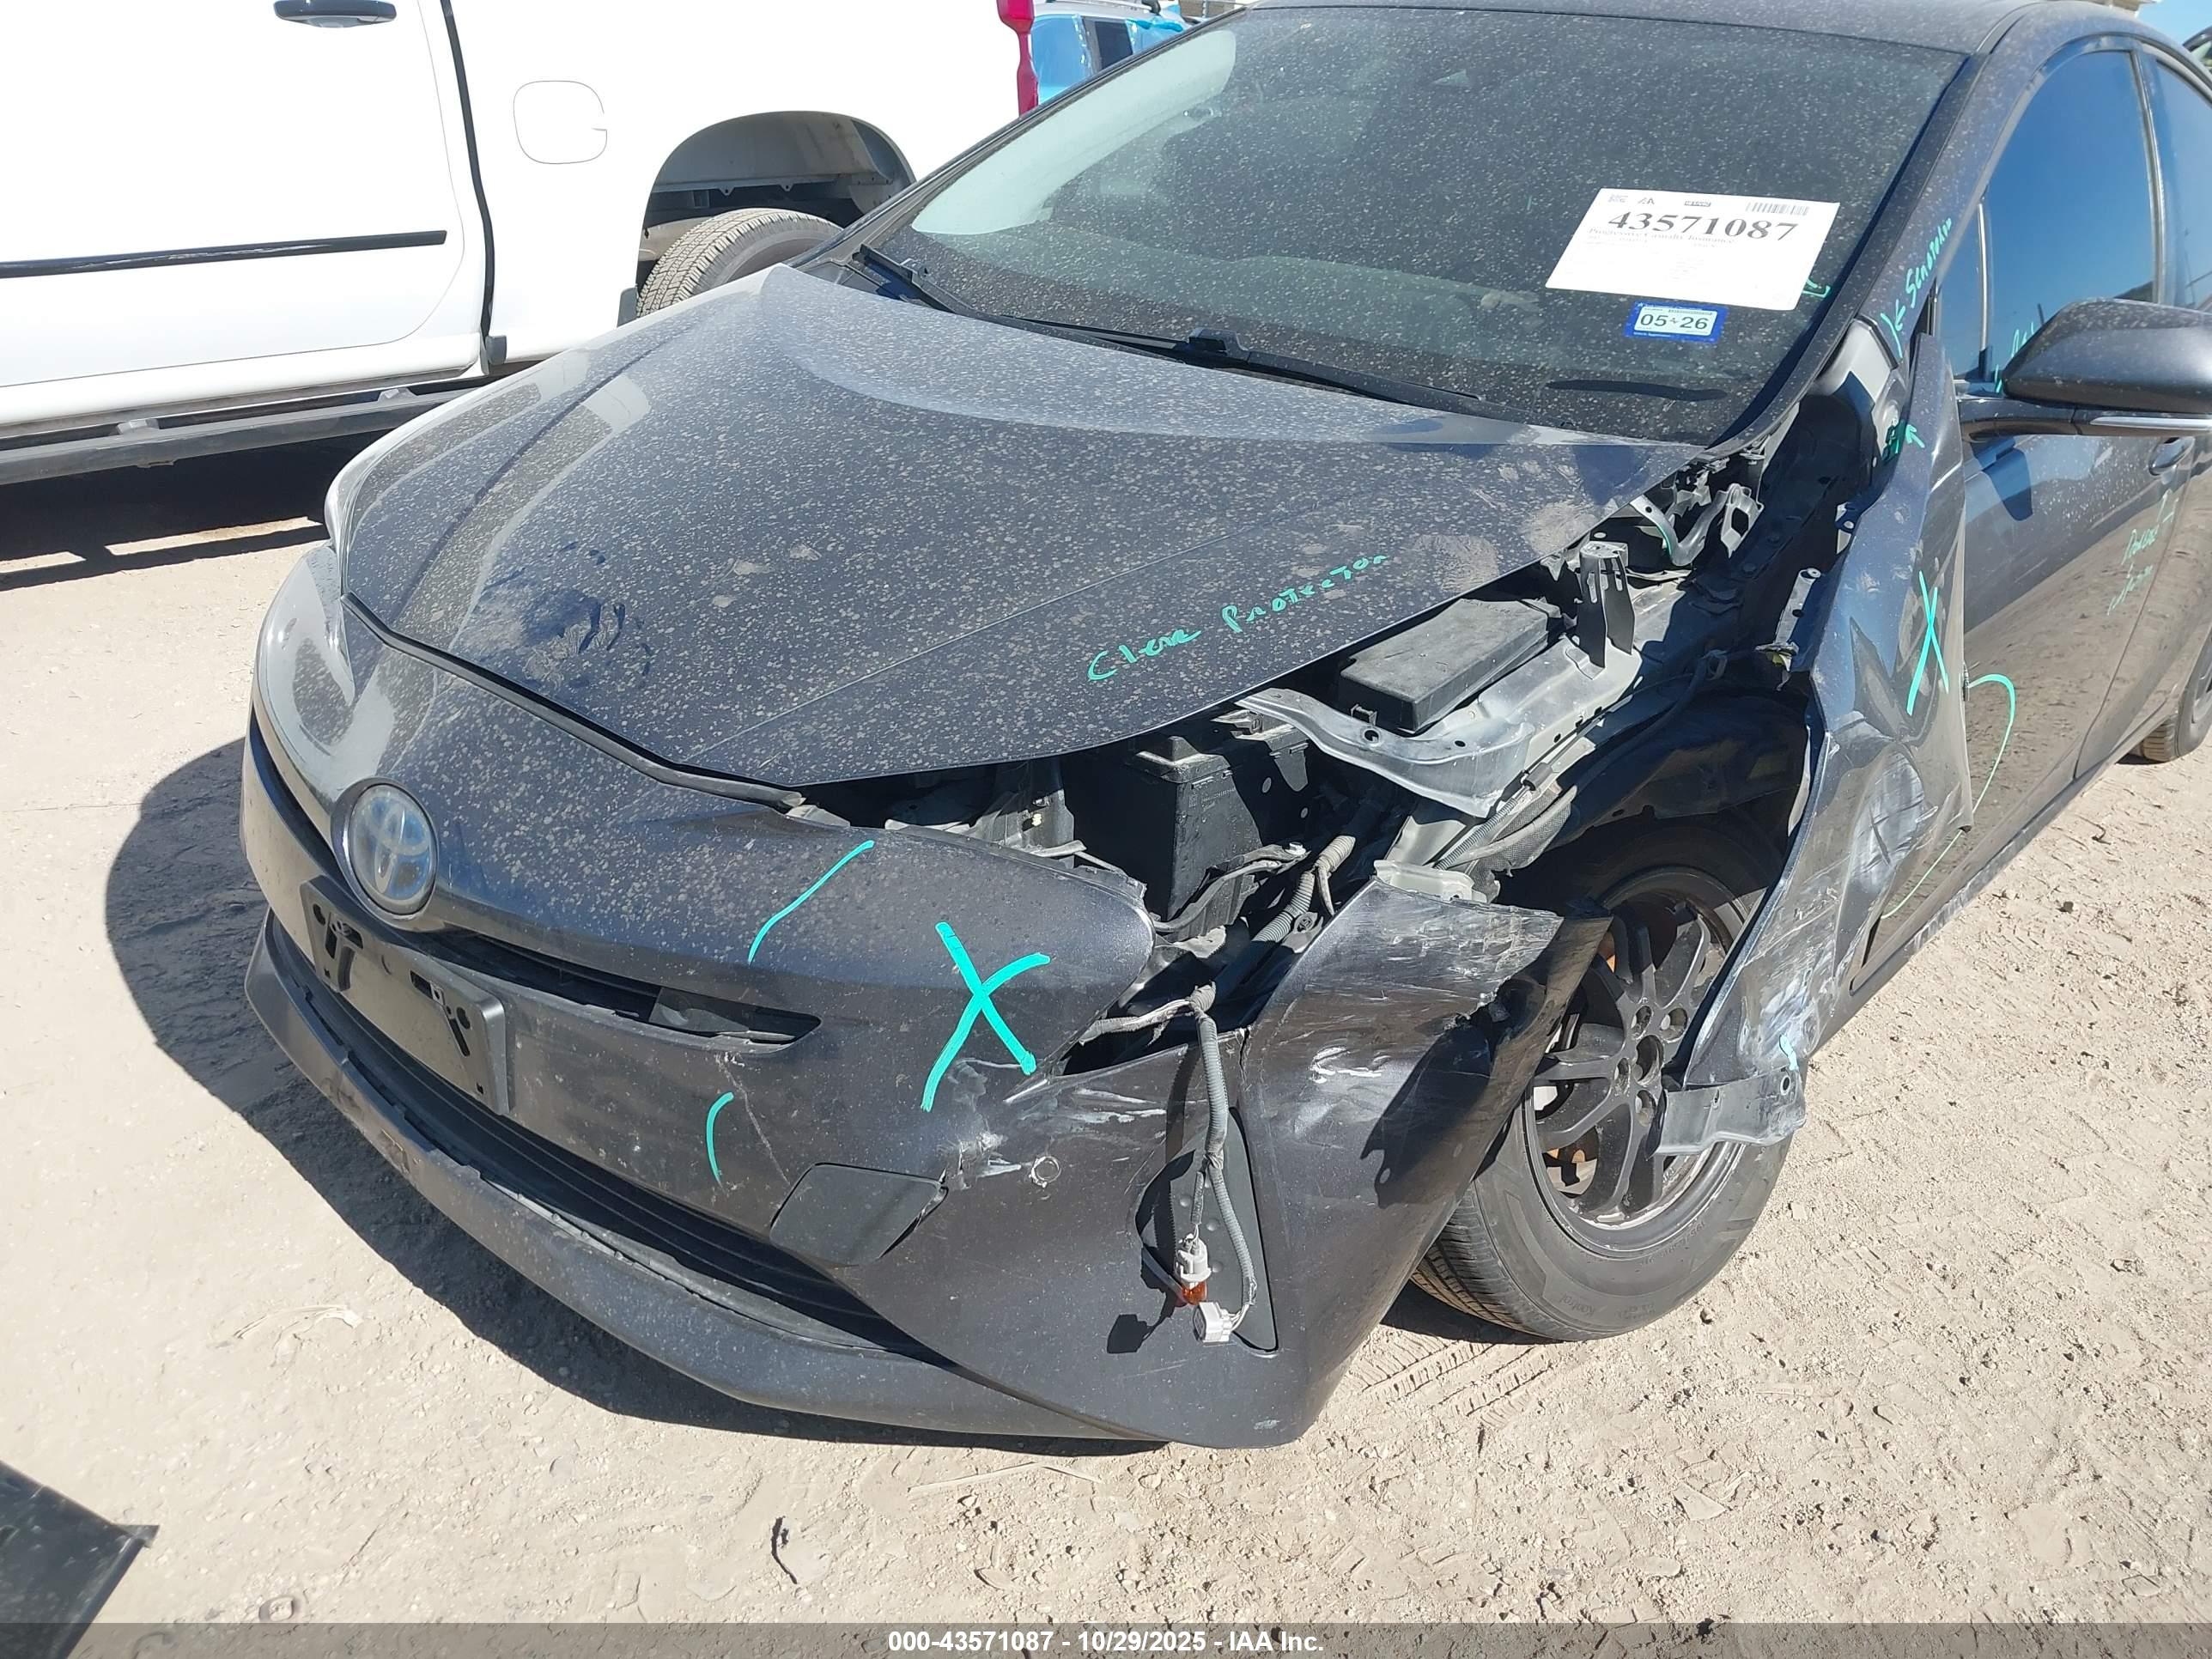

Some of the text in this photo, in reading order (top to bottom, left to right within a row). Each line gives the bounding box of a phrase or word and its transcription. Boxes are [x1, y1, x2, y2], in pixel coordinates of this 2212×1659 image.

[1607, 210, 1799, 240] 43571087
[1639, 313, 1710, 330] 05 26
